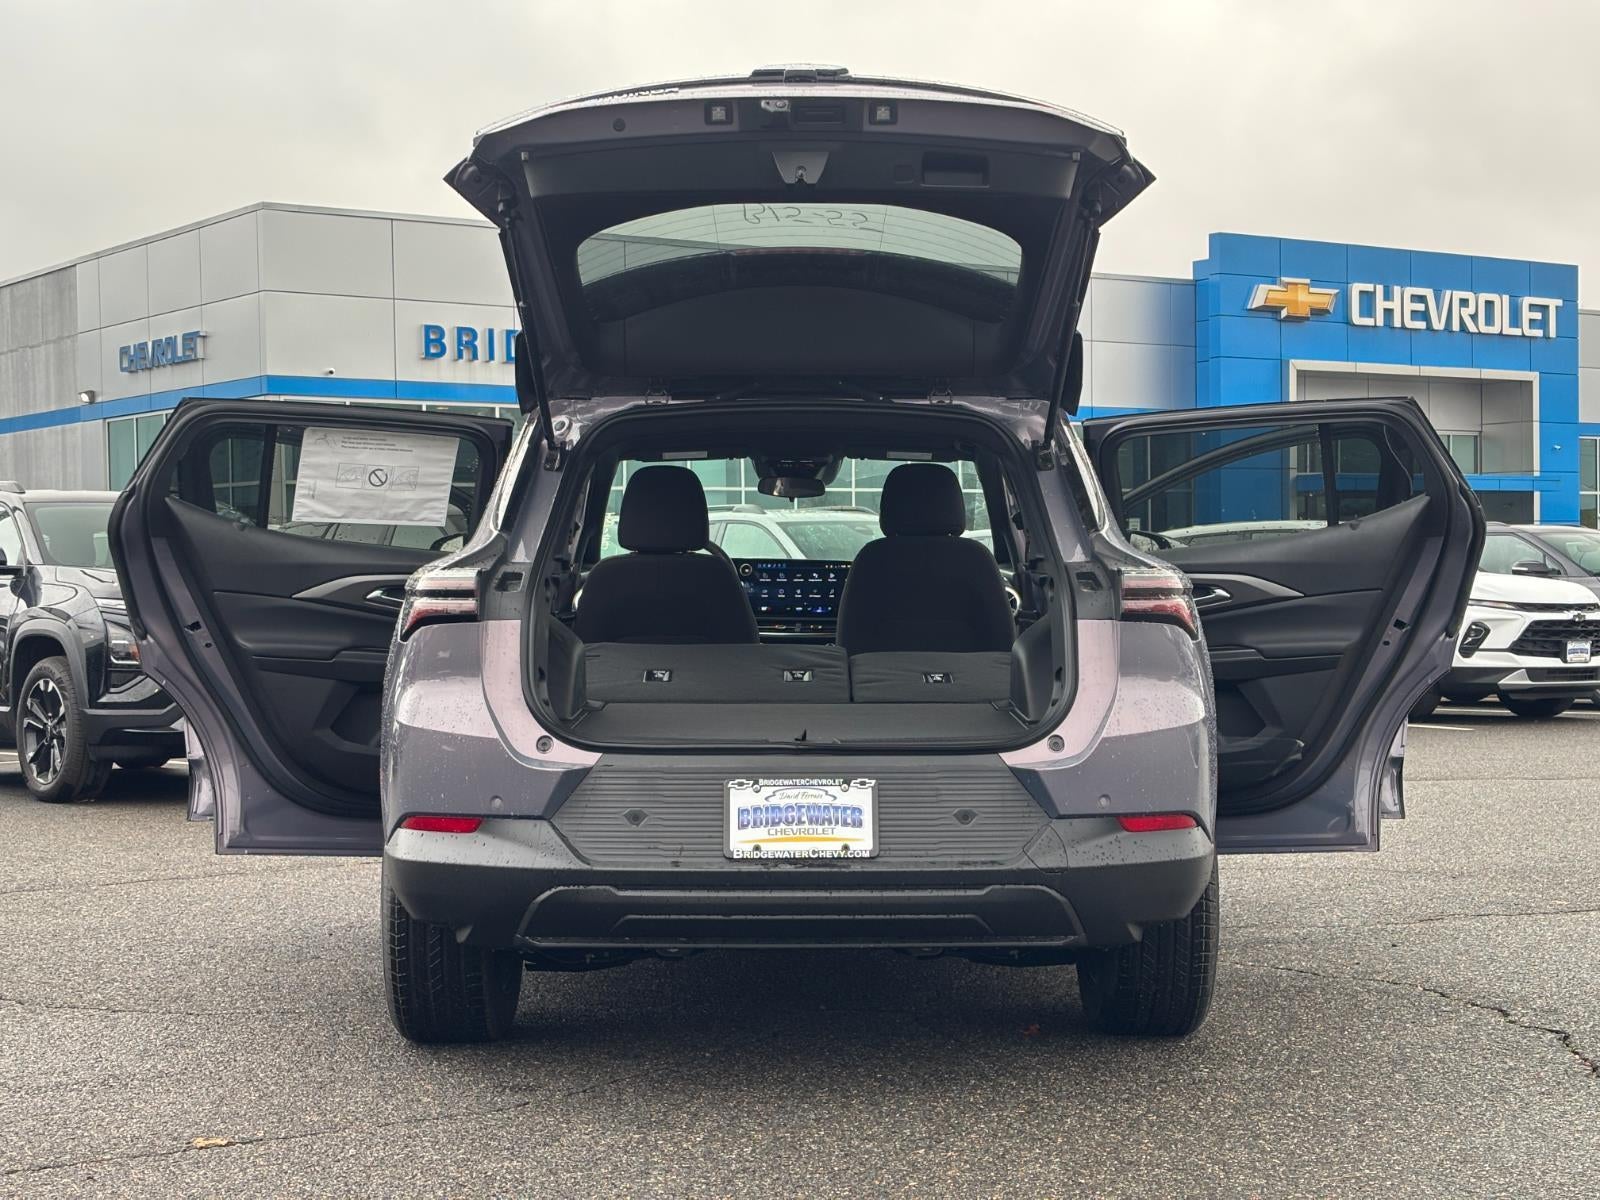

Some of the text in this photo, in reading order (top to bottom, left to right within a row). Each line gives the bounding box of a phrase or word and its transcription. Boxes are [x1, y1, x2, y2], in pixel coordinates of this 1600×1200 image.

[1350, 282, 1563, 339] CHEVROLET
[119, 330, 207, 373] CHEVROLET
[737, 803, 864, 830] BRIDGEWATER
[767, 827, 837, 836] CHEVROLET
